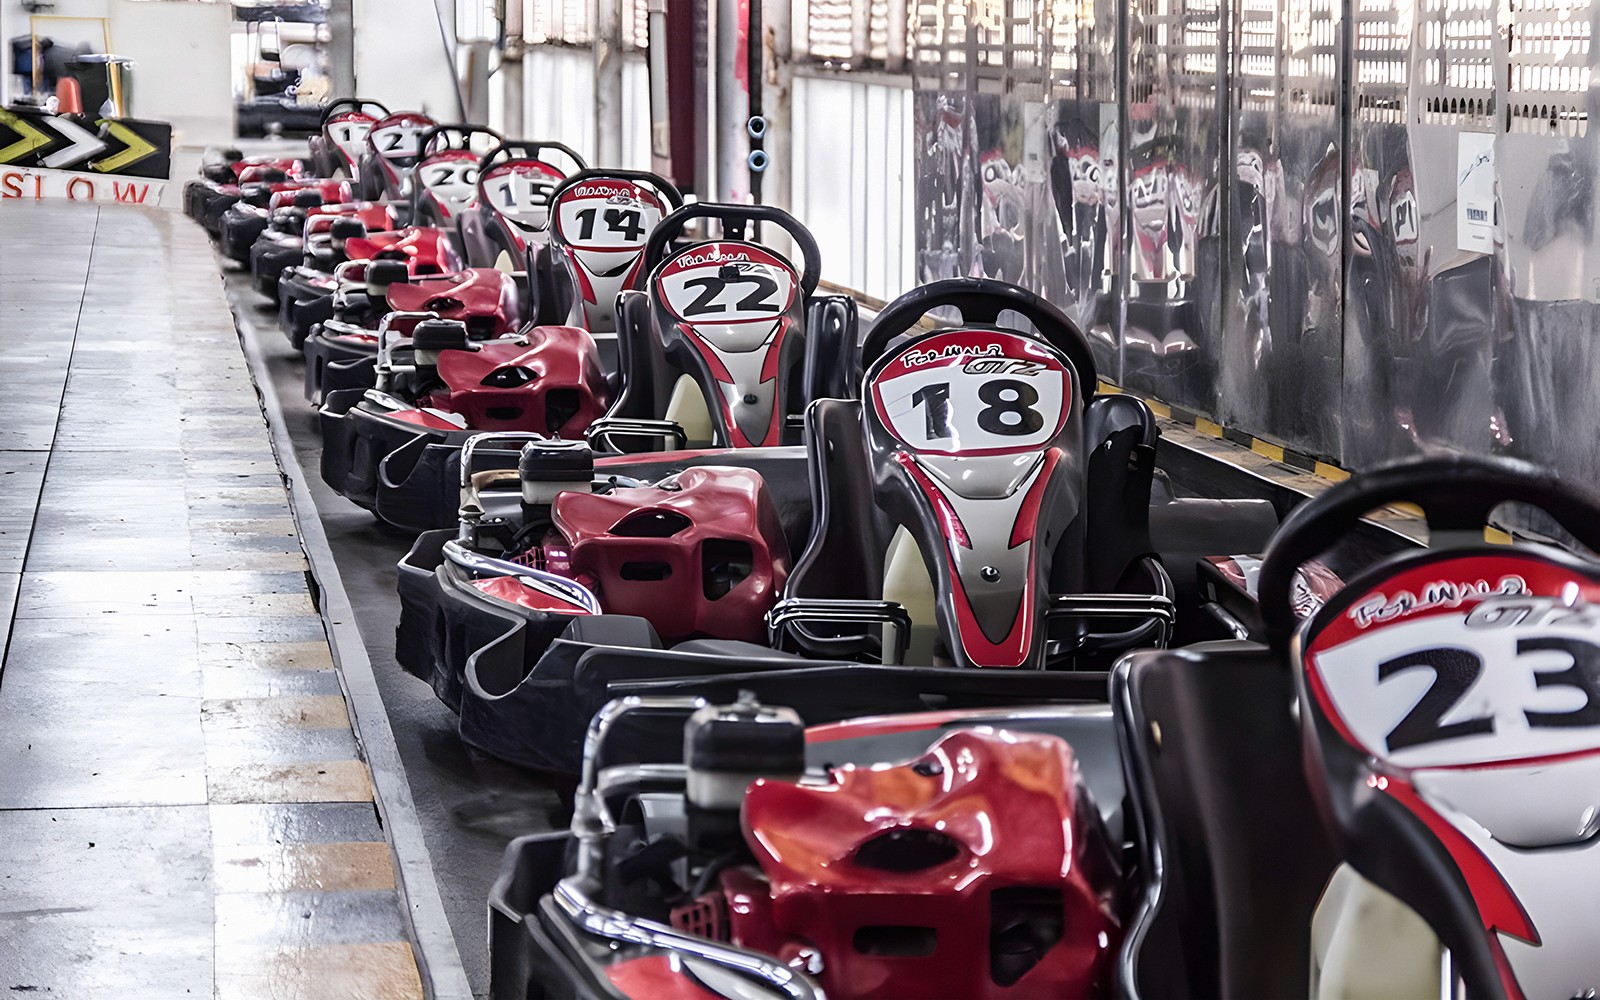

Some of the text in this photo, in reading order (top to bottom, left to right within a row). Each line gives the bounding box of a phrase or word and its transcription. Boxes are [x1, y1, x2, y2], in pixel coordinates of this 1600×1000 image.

[431, 166, 477, 187] 20
[498, 182, 555, 207] 15
[575, 208, 646, 242] 14
[682, 275, 780, 317] 22
[911, 379, 1045, 441] 18
[1378, 636, 1600, 753] 23
